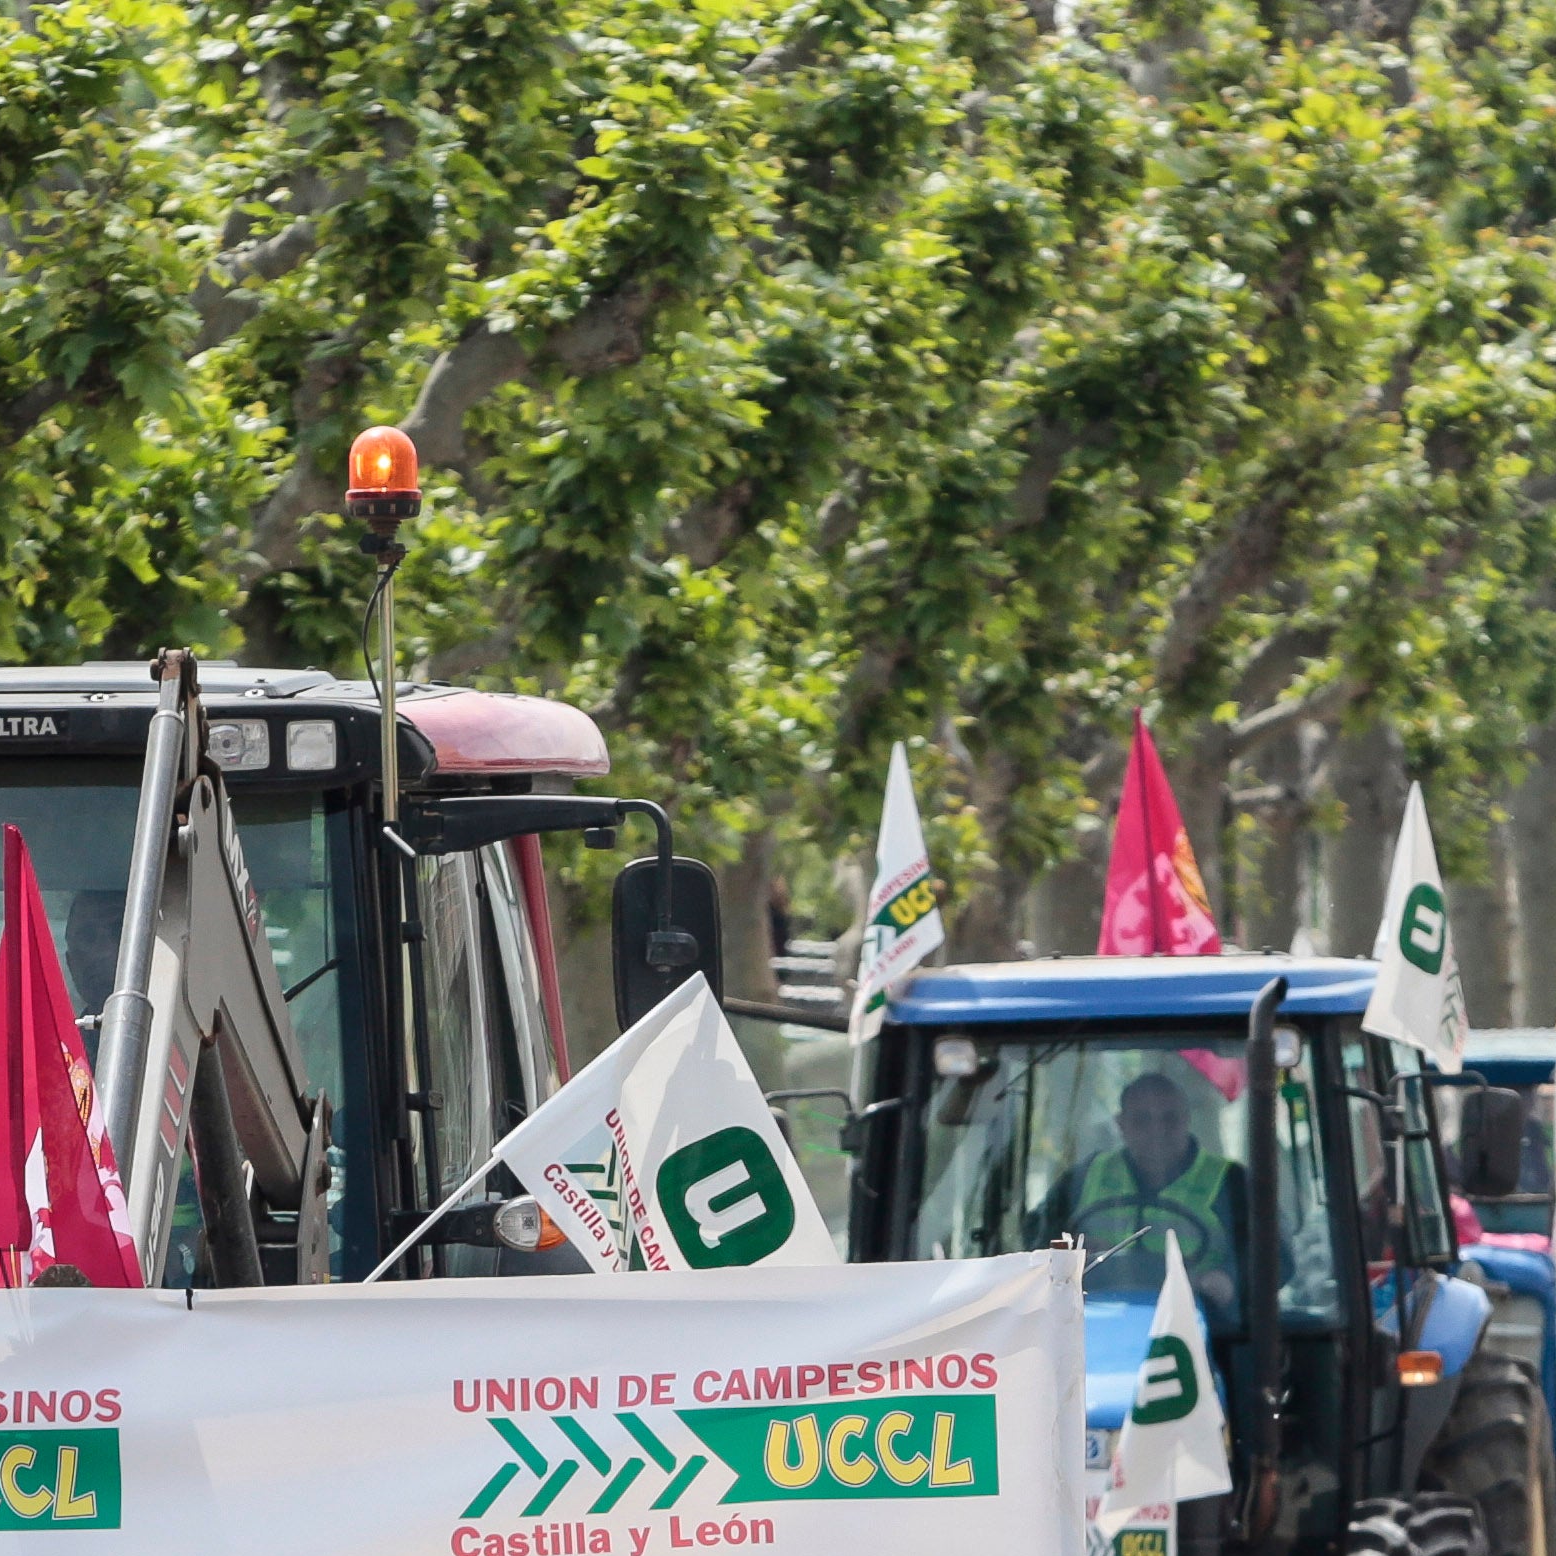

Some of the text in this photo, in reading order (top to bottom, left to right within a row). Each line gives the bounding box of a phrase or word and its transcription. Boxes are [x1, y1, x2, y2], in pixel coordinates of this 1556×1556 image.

[604, 1107, 648, 1224] UNION DE
[543, 1162, 615, 1259] Castilla y
[453, 1353, 998, 1413] UNION DE CAMPESINOS
[763, 1410, 976, 1490] UCCL
[670, 1516, 775, 1549] León
